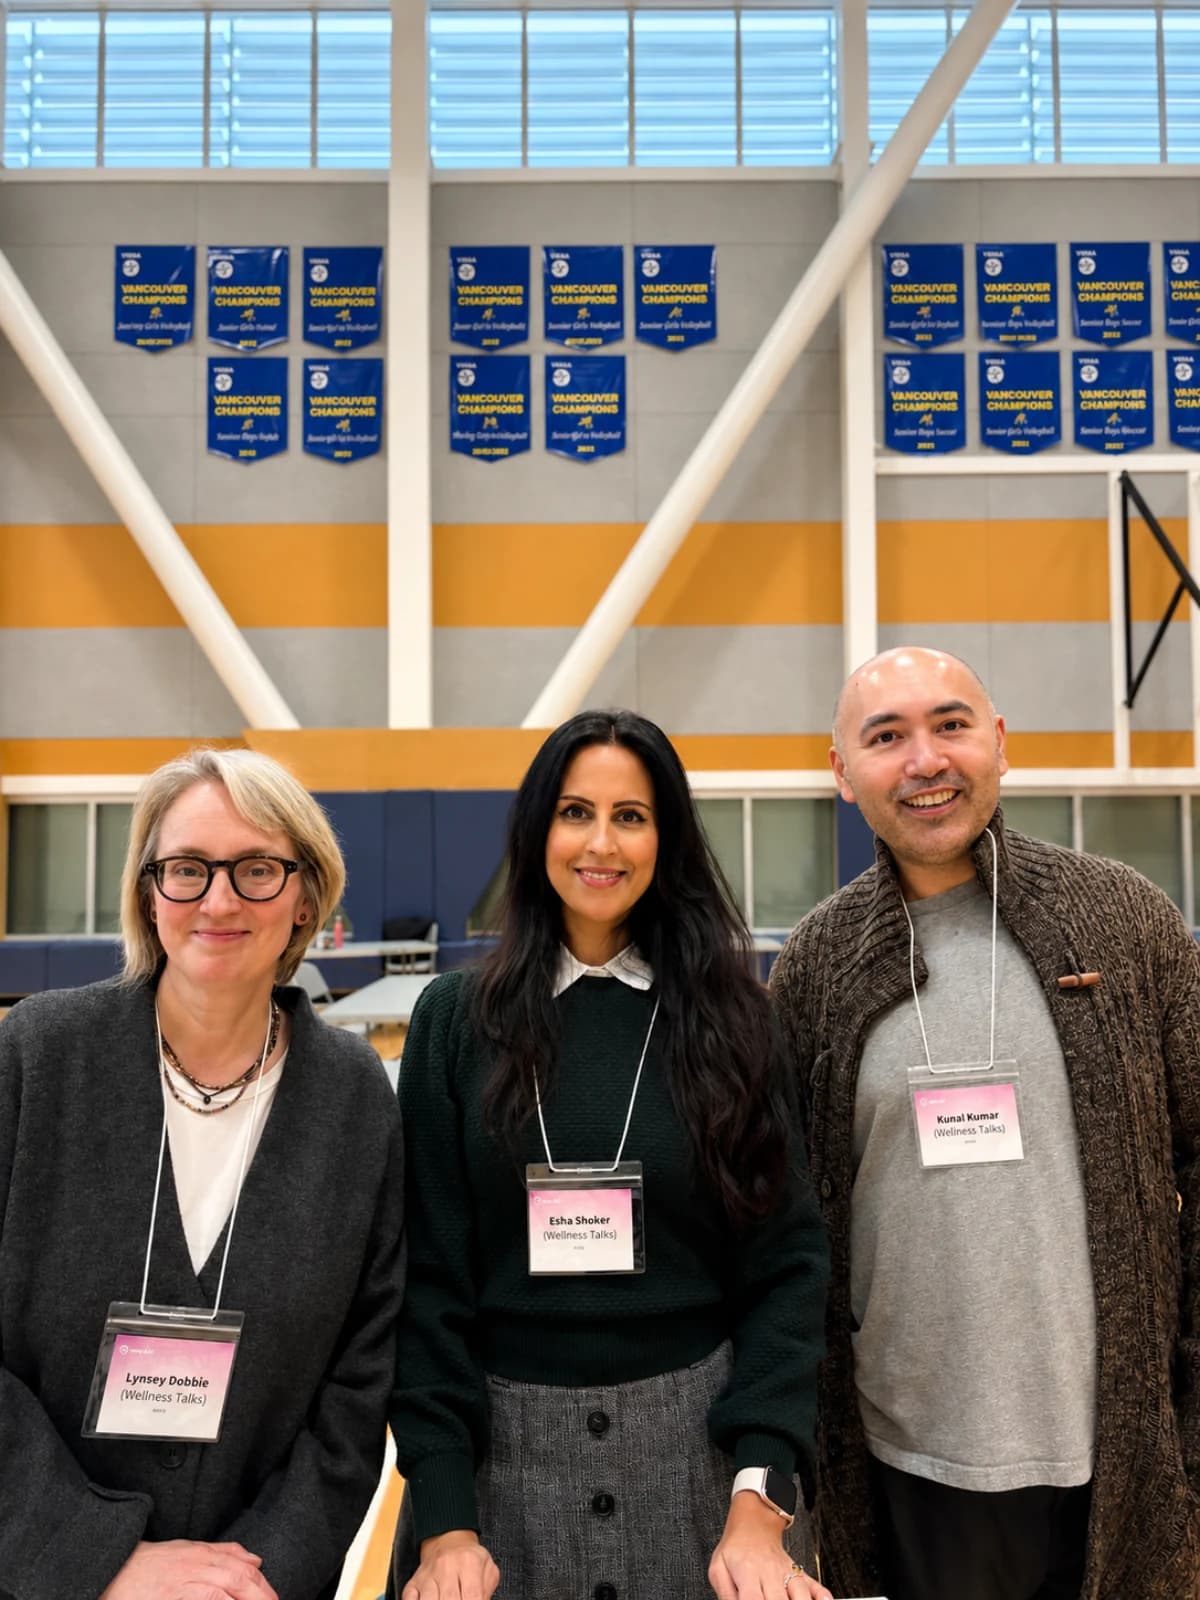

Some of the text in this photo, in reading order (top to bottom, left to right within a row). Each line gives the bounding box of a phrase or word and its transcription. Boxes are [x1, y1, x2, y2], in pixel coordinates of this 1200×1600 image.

[122, 285, 187, 293] VANCOUVER
[457, 286, 523, 294] VANCOUVER
[551, 285, 617, 293] VANCOUVER
[642, 284, 707, 292] VANCOUVER
[891, 284, 956, 292] VANCOUVER
[984, 283, 1050, 291] VANCOUVER
[1078, 282, 1143, 290] VANCOUVER
[122, 296, 186, 304] CHAMPIONS
[551, 296, 616, 304] CHAMPIONS
[642, 295, 707, 303] CHAMPIONS
[891, 295, 956, 303] CHAMPIONS
[985, 294, 1050, 302] CHAMPIONS
[1078, 293, 1143, 301] CHAMPIONS
[310, 298, 374, 306] CHAMPIONS
[552, 394, 618, 402] VANCOUVER
[891, 392, 957, 400] VANCOUVER
[987, 391, 1052, 399] VANCOUVER
[1080, 390, 1145, 398] VANCOUVER
[214, 396, 280, 404] VANCOUVER
[310, 397, 376, 405] VANCOUVER
[457, 394, 523, 403] VANCOUVER
[458, 405, 523, 413] CHAMPIONS
[553, 405, 617, 413] CHAMPIONS
[892, 402, 957, 410] CHAMPIONS
[1081, 401, 1145, 409] CHAMPIONS
[215, 407, 280, 415] CHAMPIONS
[310, 408, 375, 416] CHAMPIONS
[937, 1112, 999, 1124] Kunal Kumar
[934, 1124, 1006, 1139] (Wellness Talks)
[549, 1216, 610, 1225] Esha Shoker
[543, 1230, 617, 1241] (Wellness Talks)
[126, 1372, 209, 1388] Lynsey Dobbie
[120, 1389, 207, 1406] (Wellness Talks)
